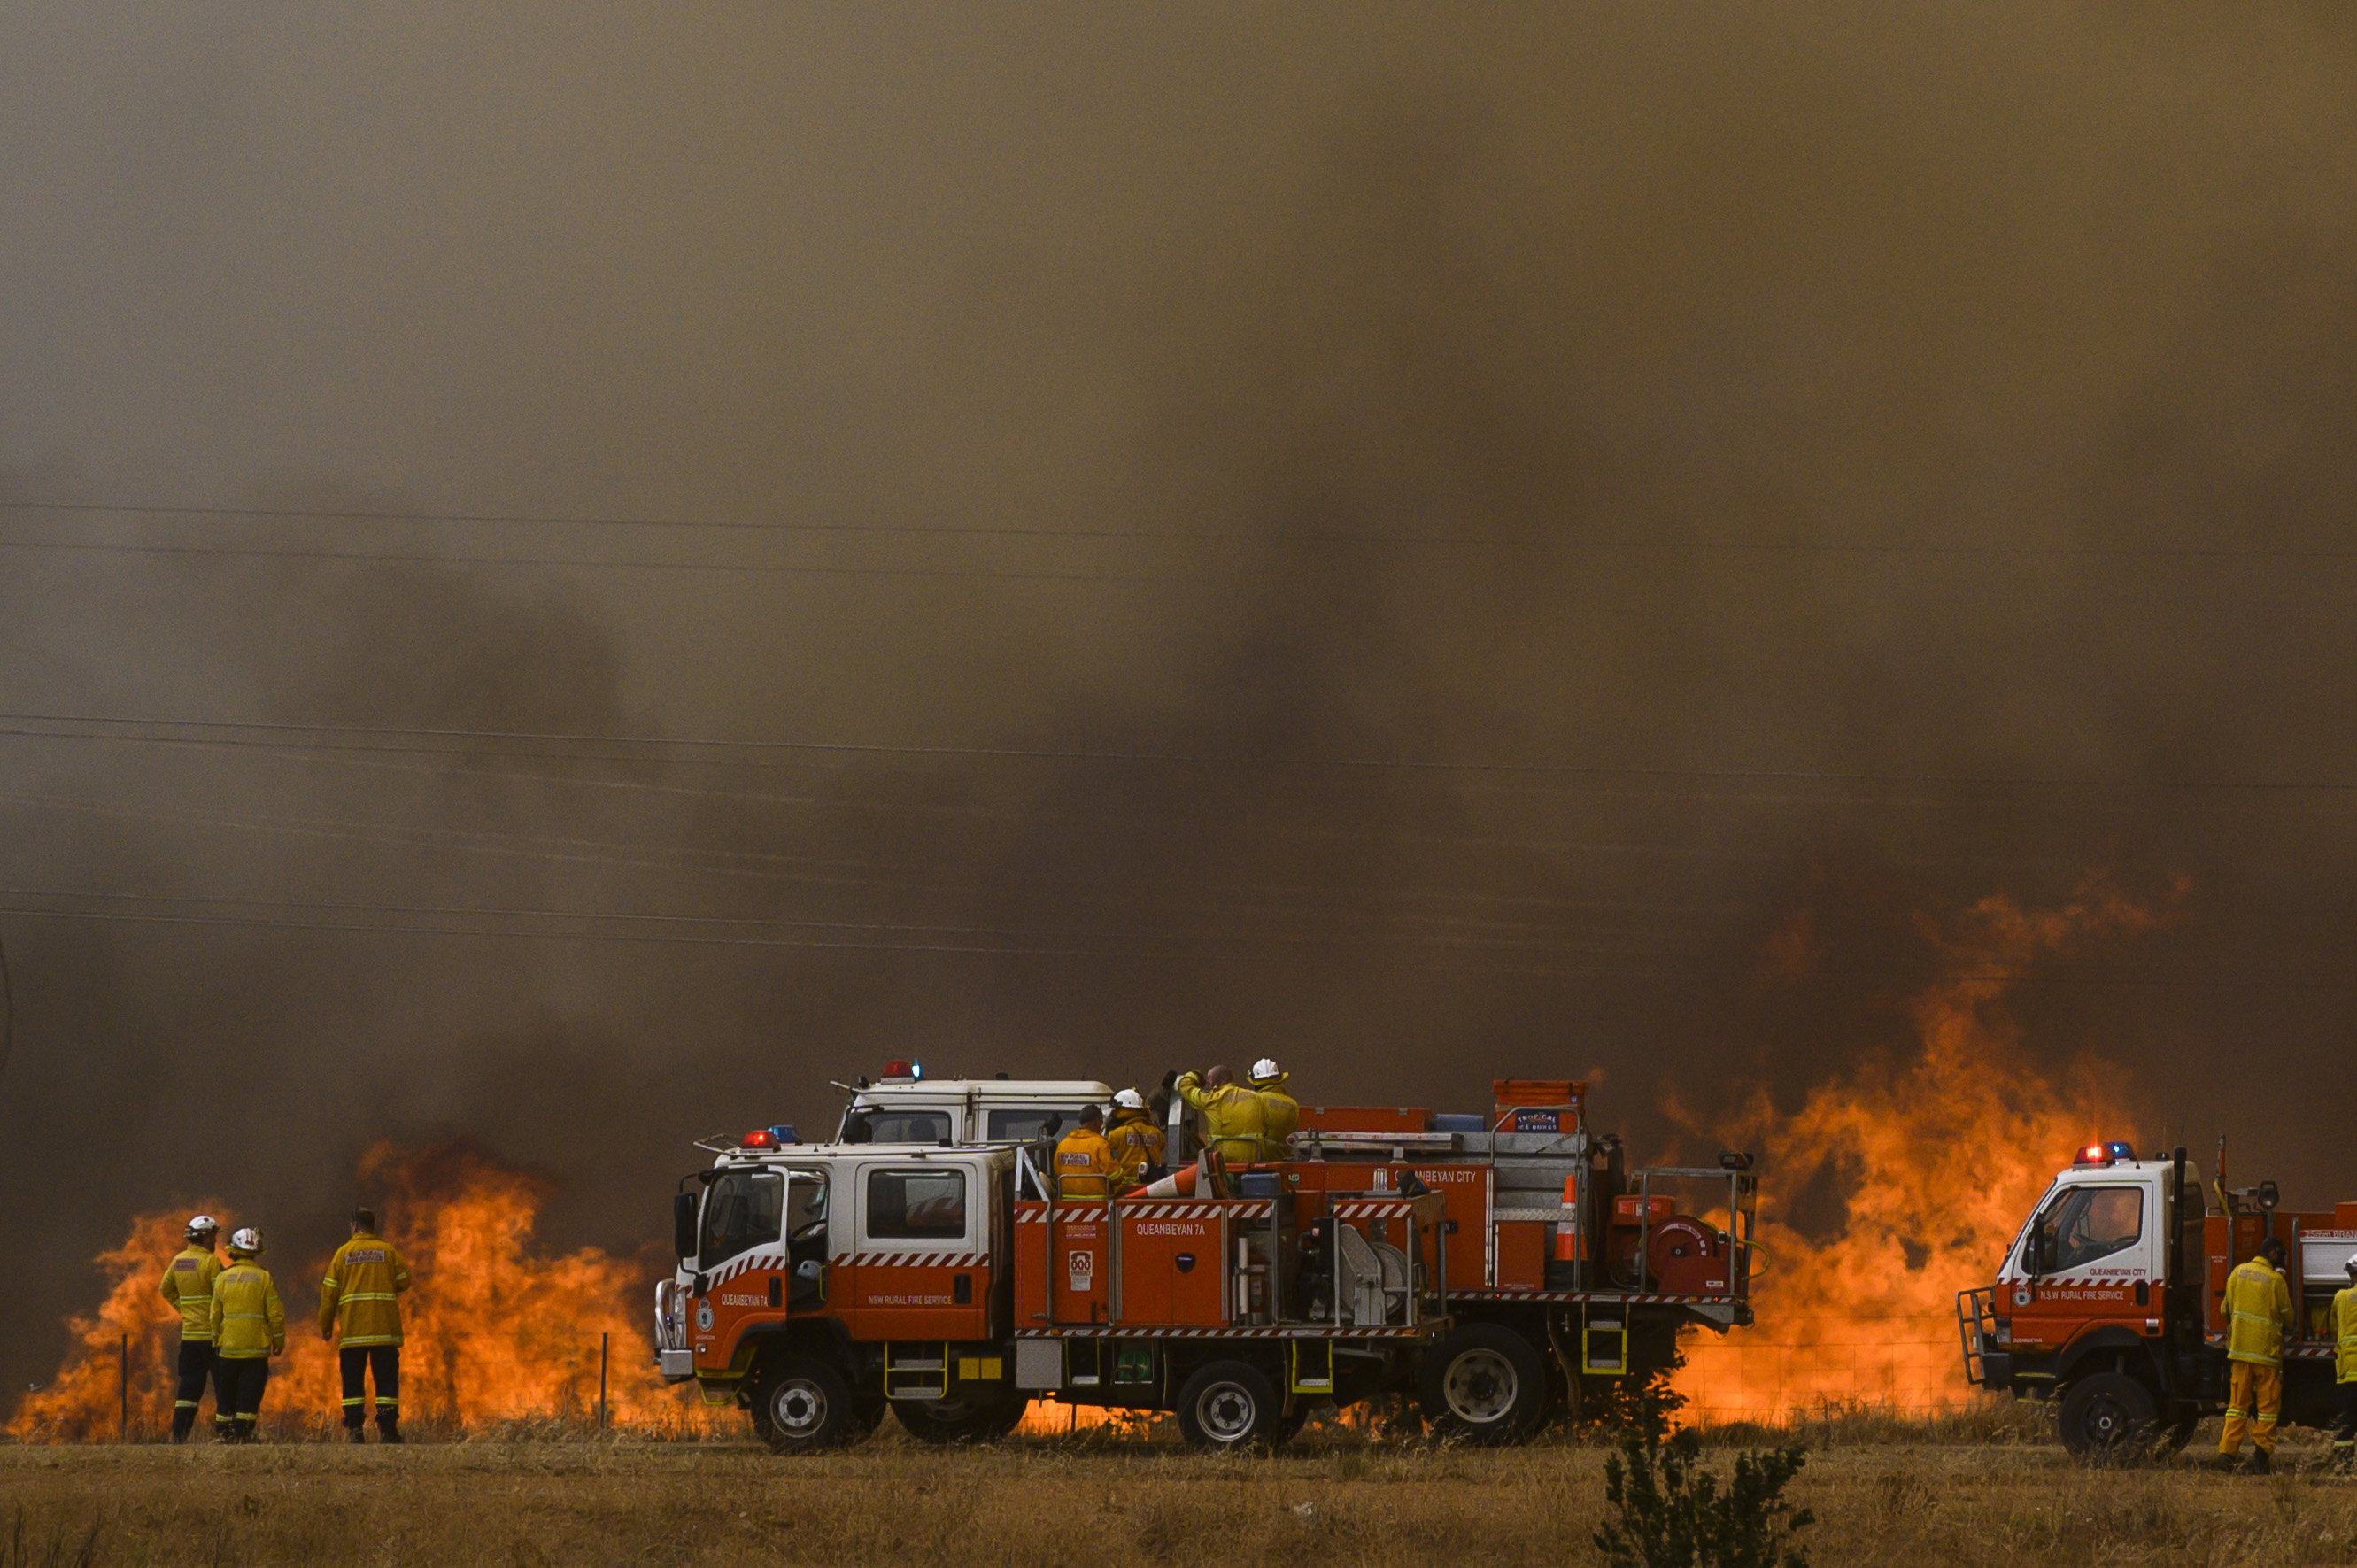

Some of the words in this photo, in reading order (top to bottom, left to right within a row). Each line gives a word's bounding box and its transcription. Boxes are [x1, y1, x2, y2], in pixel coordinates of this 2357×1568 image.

[1457, 1170, 1476, 1183] CITY
[1137, 1224, 1193, 1236] QUEANBEYAN
[1194, 1224, 1205, 1236] 7A
[1070, 1259, 1091, 1271] 000
[2090, 1268, 2131, 1277] QUEANBEYAN
[2132, 1268, 2147, 1277] CITY
[721, 1294, 760, 1307] QUEANBEYAN
[869, 1295, 884, 1304] NSW
[885, 1295, 907, 1304] RURAL
[908, 1295, 923, 1304] FIRE
[923, 1295, 952, 1304] SERVICE
[2061, 1290, 2082, 1301] RURAL
[2083, 1290, 2097, 1301] FIRE
[2098, 1290, 2124, 1301] SERVICE
